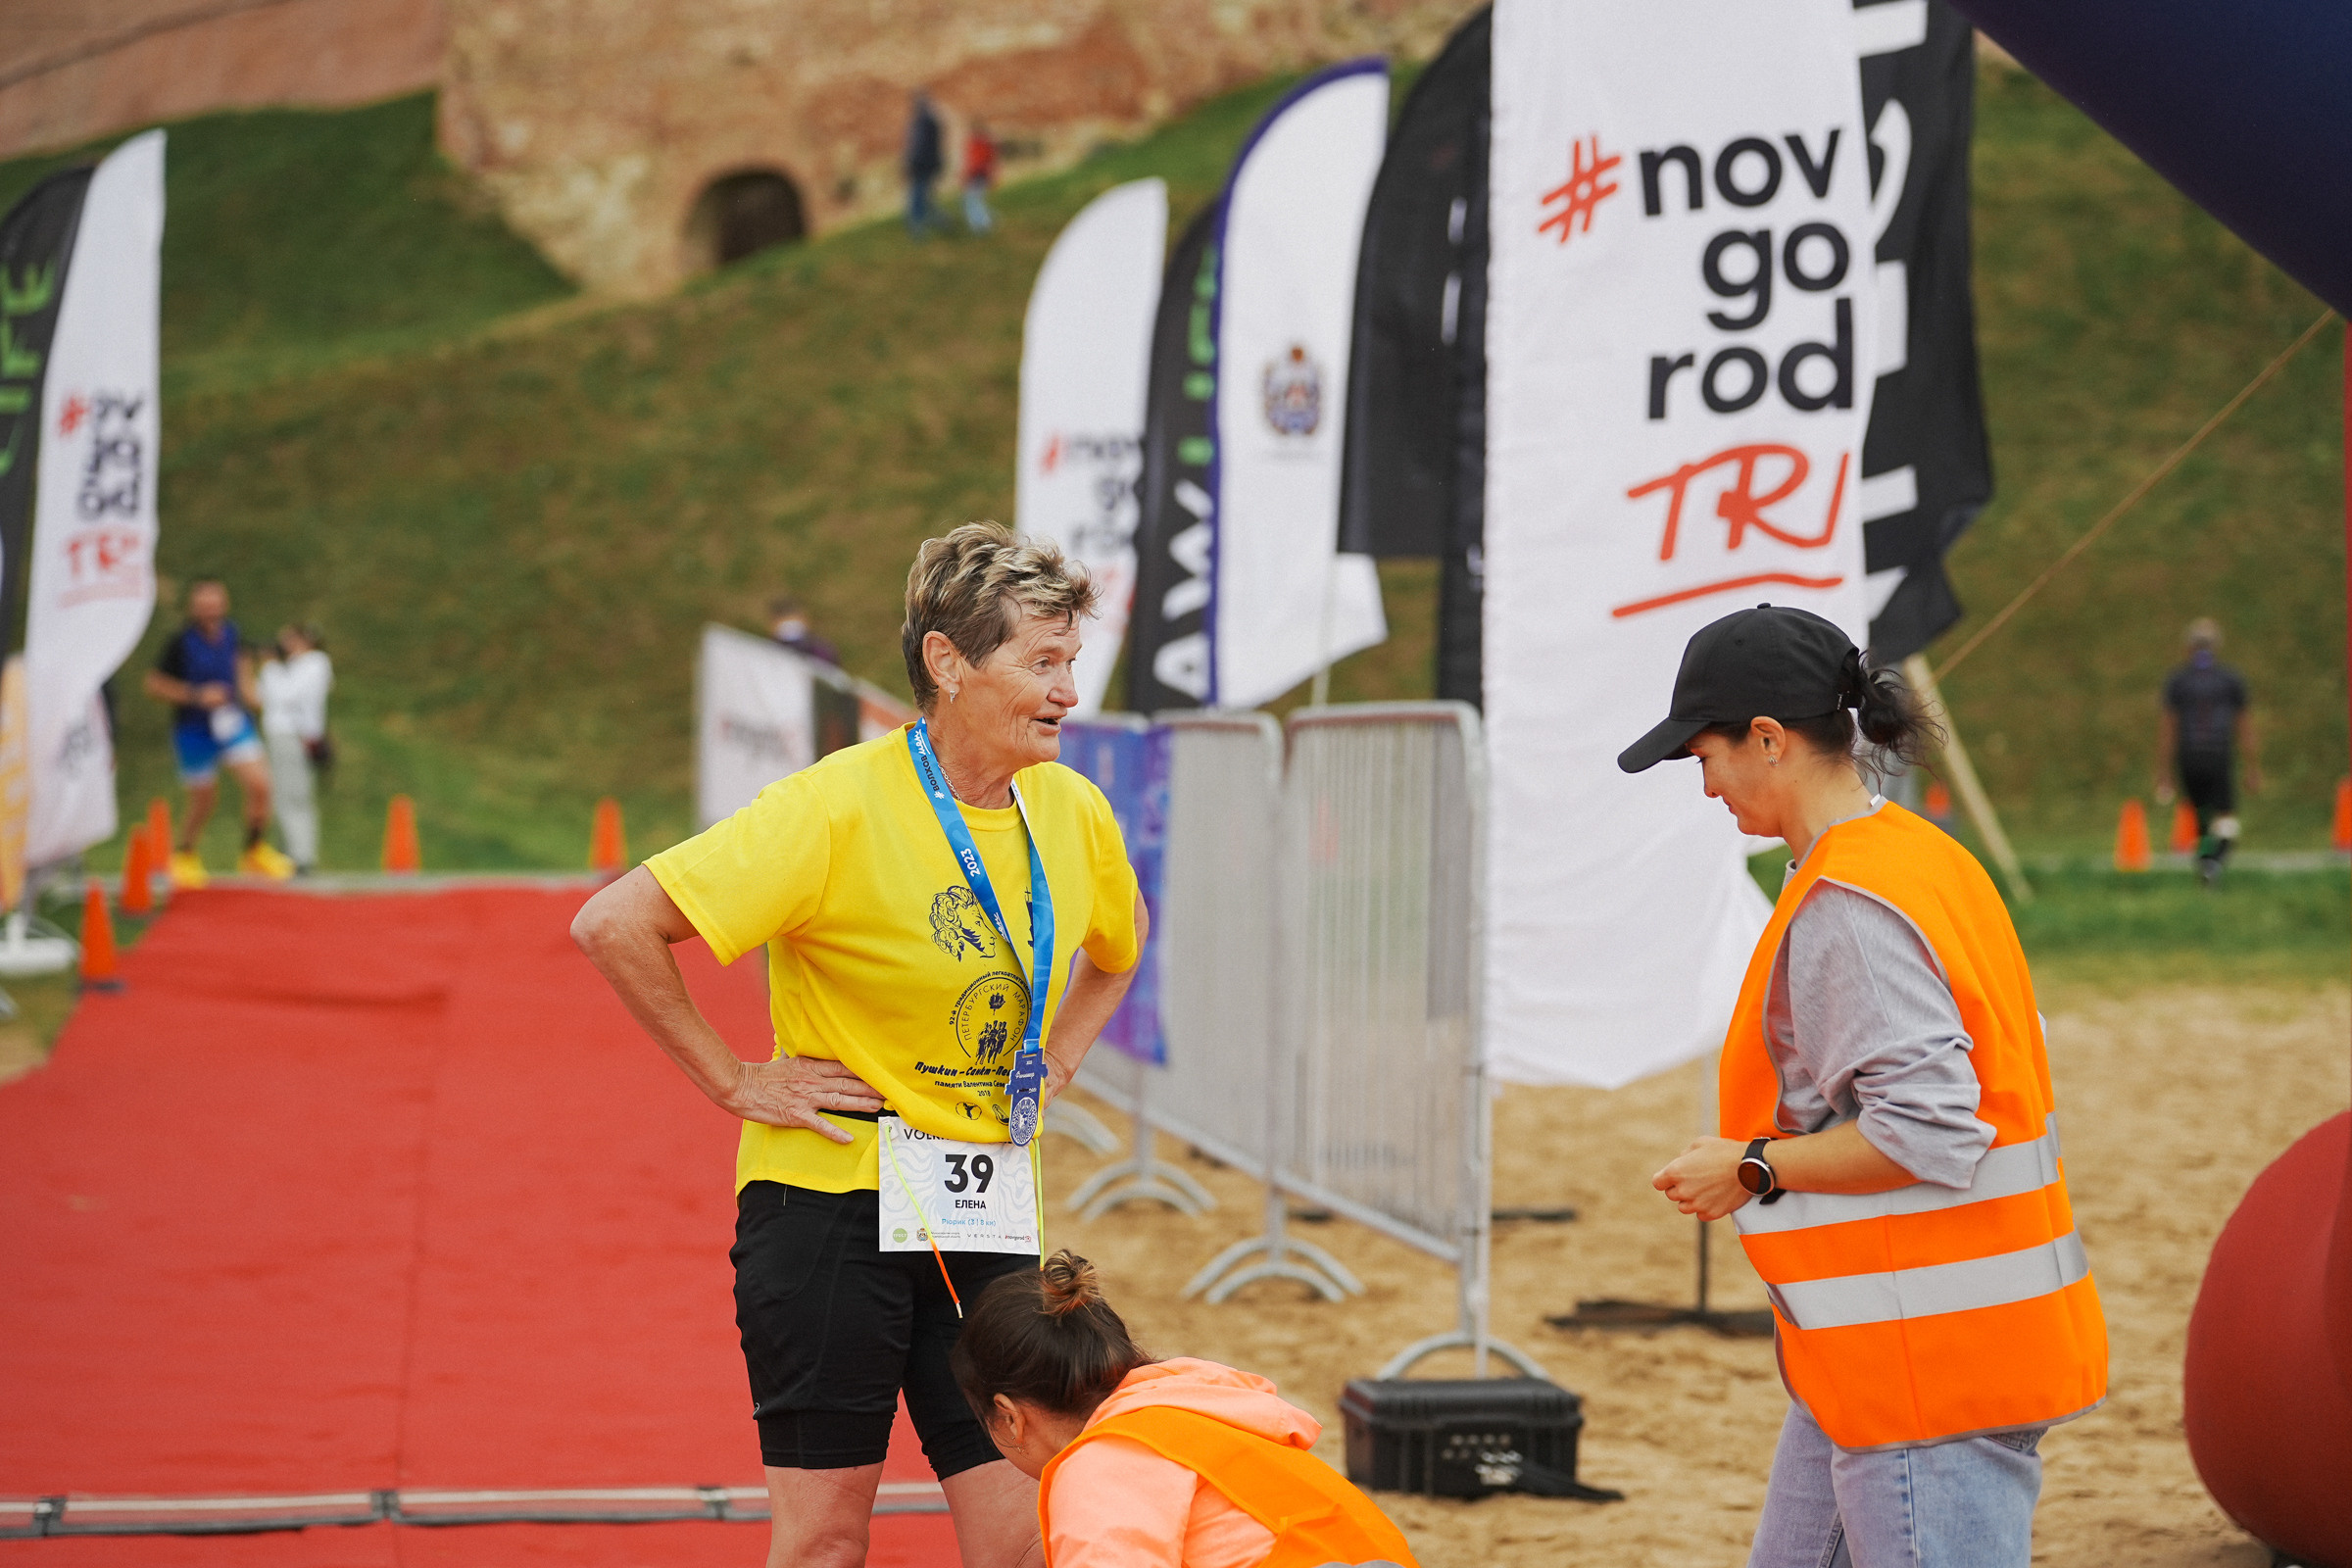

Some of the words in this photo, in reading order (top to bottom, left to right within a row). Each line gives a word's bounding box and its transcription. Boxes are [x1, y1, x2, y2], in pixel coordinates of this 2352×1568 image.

[1536, 128, 1842, 245] #nov
[1701, 221, 1850, 332] go
[1646, 296, 1855, 420] rod
[1627, 443, 1850, 563] TRI
[960, 848, 981, 877] 2023
[961, 983, 1010, 1041] ПЕТЕРБУРГСКИЙ
[1009, 991, 1026, 1041] МАРАФОН
[944, 1153, 994, 1194] 39
[955, 1200, 987, 1209] ЕЛЕНА
